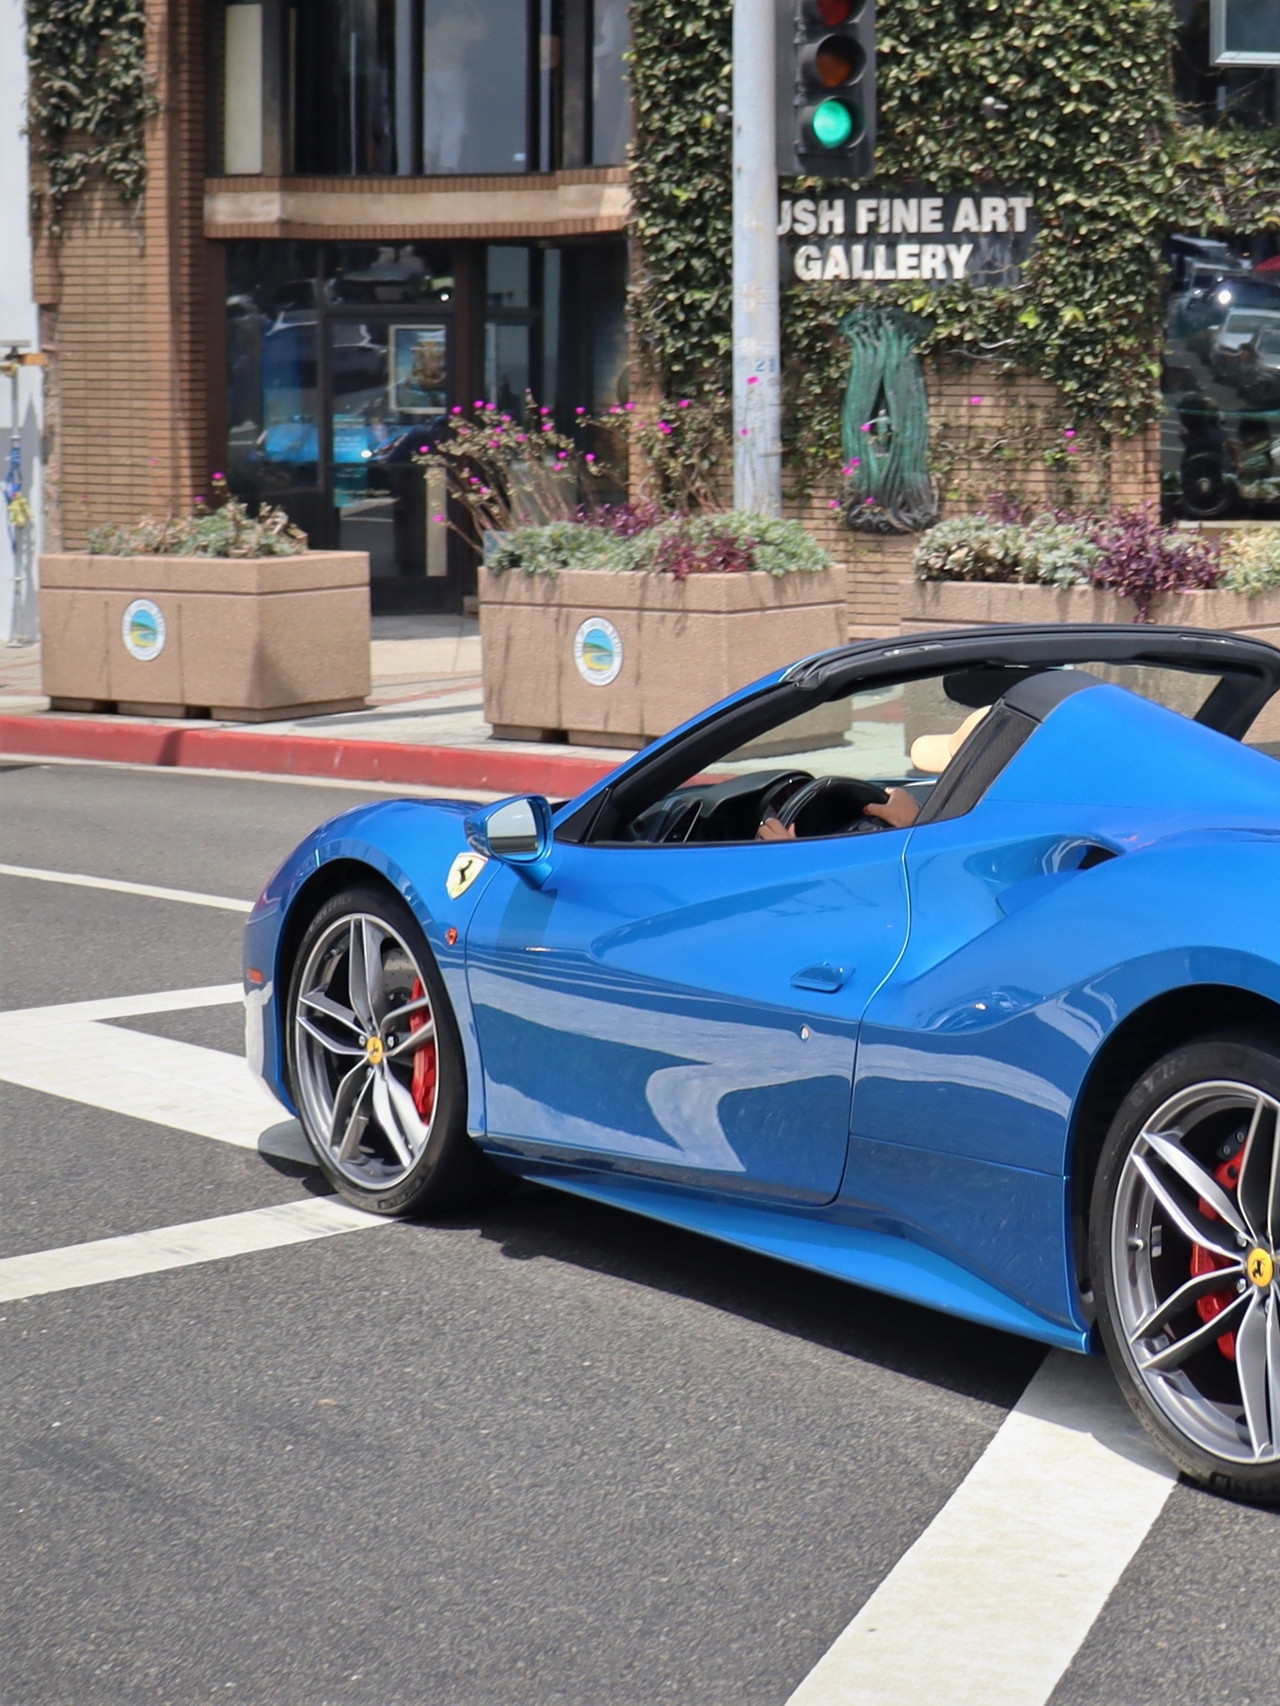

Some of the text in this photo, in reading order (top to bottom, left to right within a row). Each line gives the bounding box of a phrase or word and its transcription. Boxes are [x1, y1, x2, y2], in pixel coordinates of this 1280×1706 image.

[777, 196, 1034, 235] USH FINE ART
[794, 243, 974, 281] GALLERY
